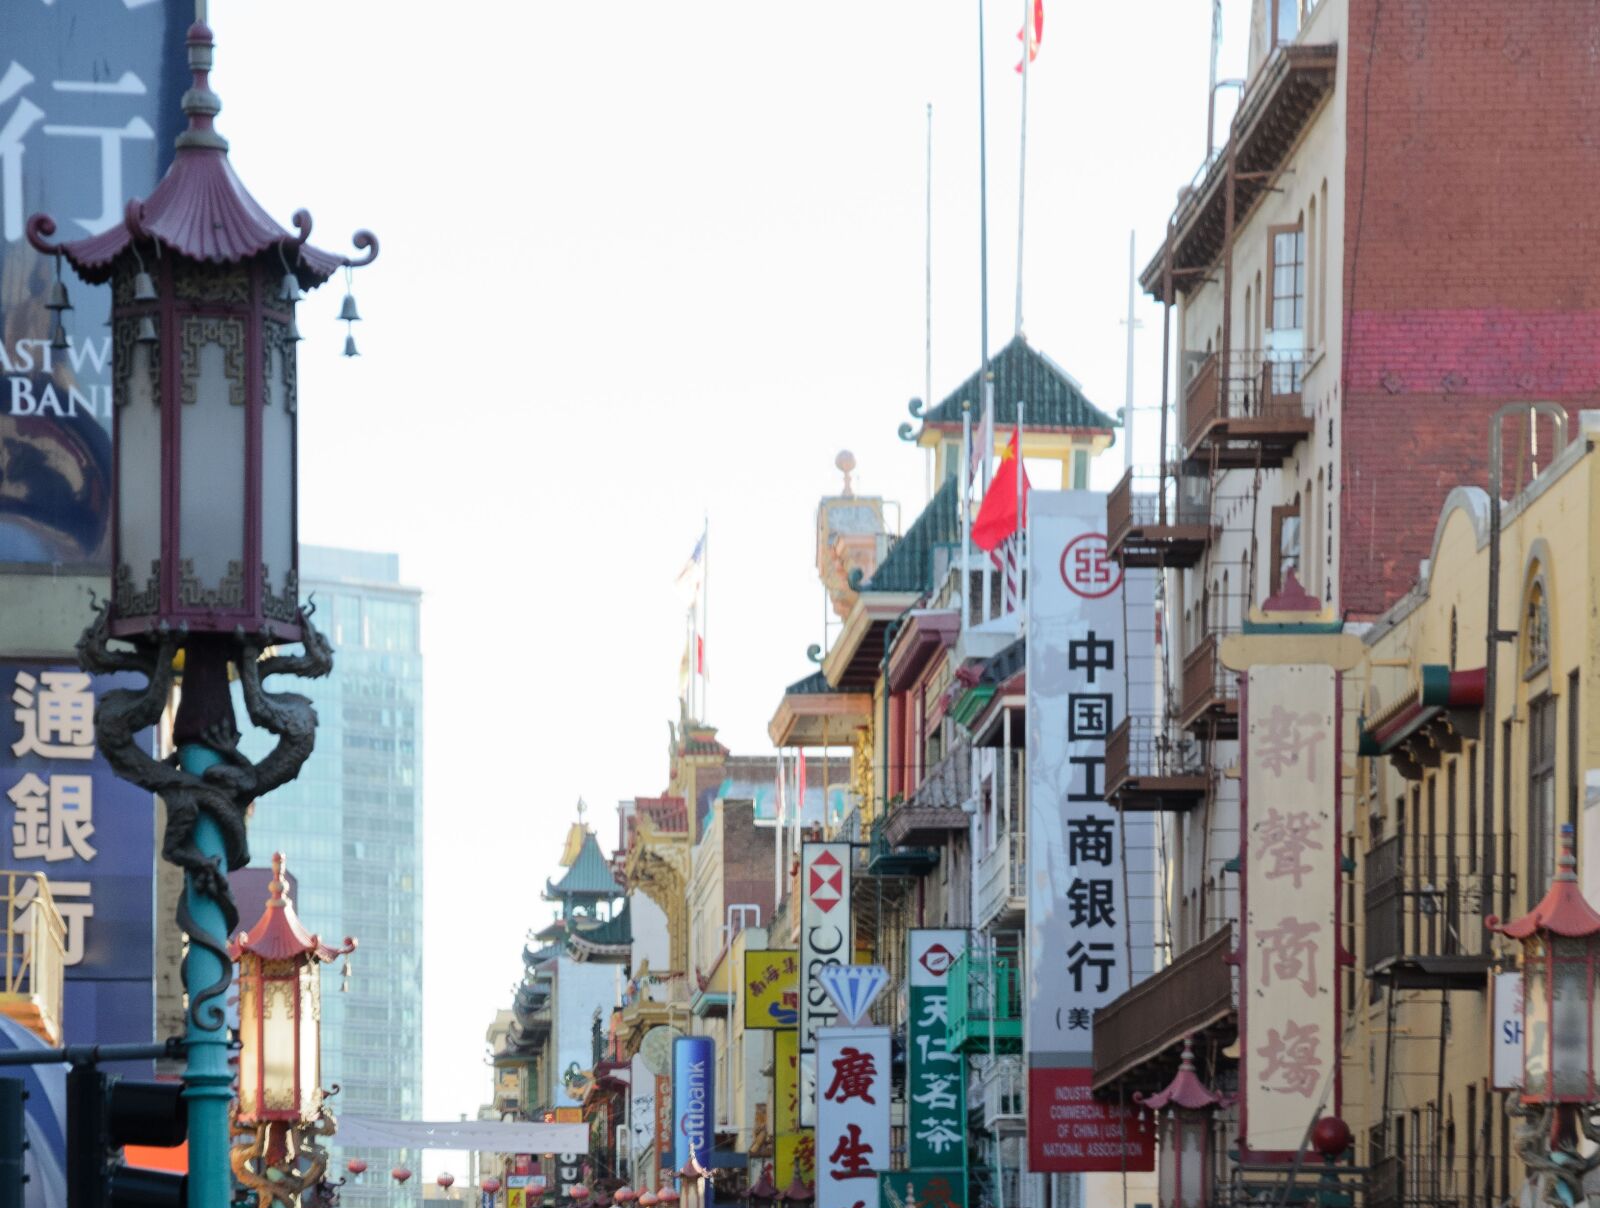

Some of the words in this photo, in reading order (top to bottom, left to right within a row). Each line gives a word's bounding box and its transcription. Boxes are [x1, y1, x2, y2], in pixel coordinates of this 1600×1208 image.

[0, 338, 53, 373] AST
[9, 376, 112, 417] BAN
[1066, 630, 1117, 994] 中国工商银行
[686, 1060, 705, 1150] citibank
[1055, 1086, 1093, 1101] INDUSTR
[1051, 1104, 1105, 1121] COMMERCIAL
[1057, 1124, 1070, 1138] OF
[1073, 1124, 1099, 1138] CHINA
[1043, 1142, 1083, 1157] NATIONAL
[1087, 1142, 1143, 1157] ASSOCIATION
